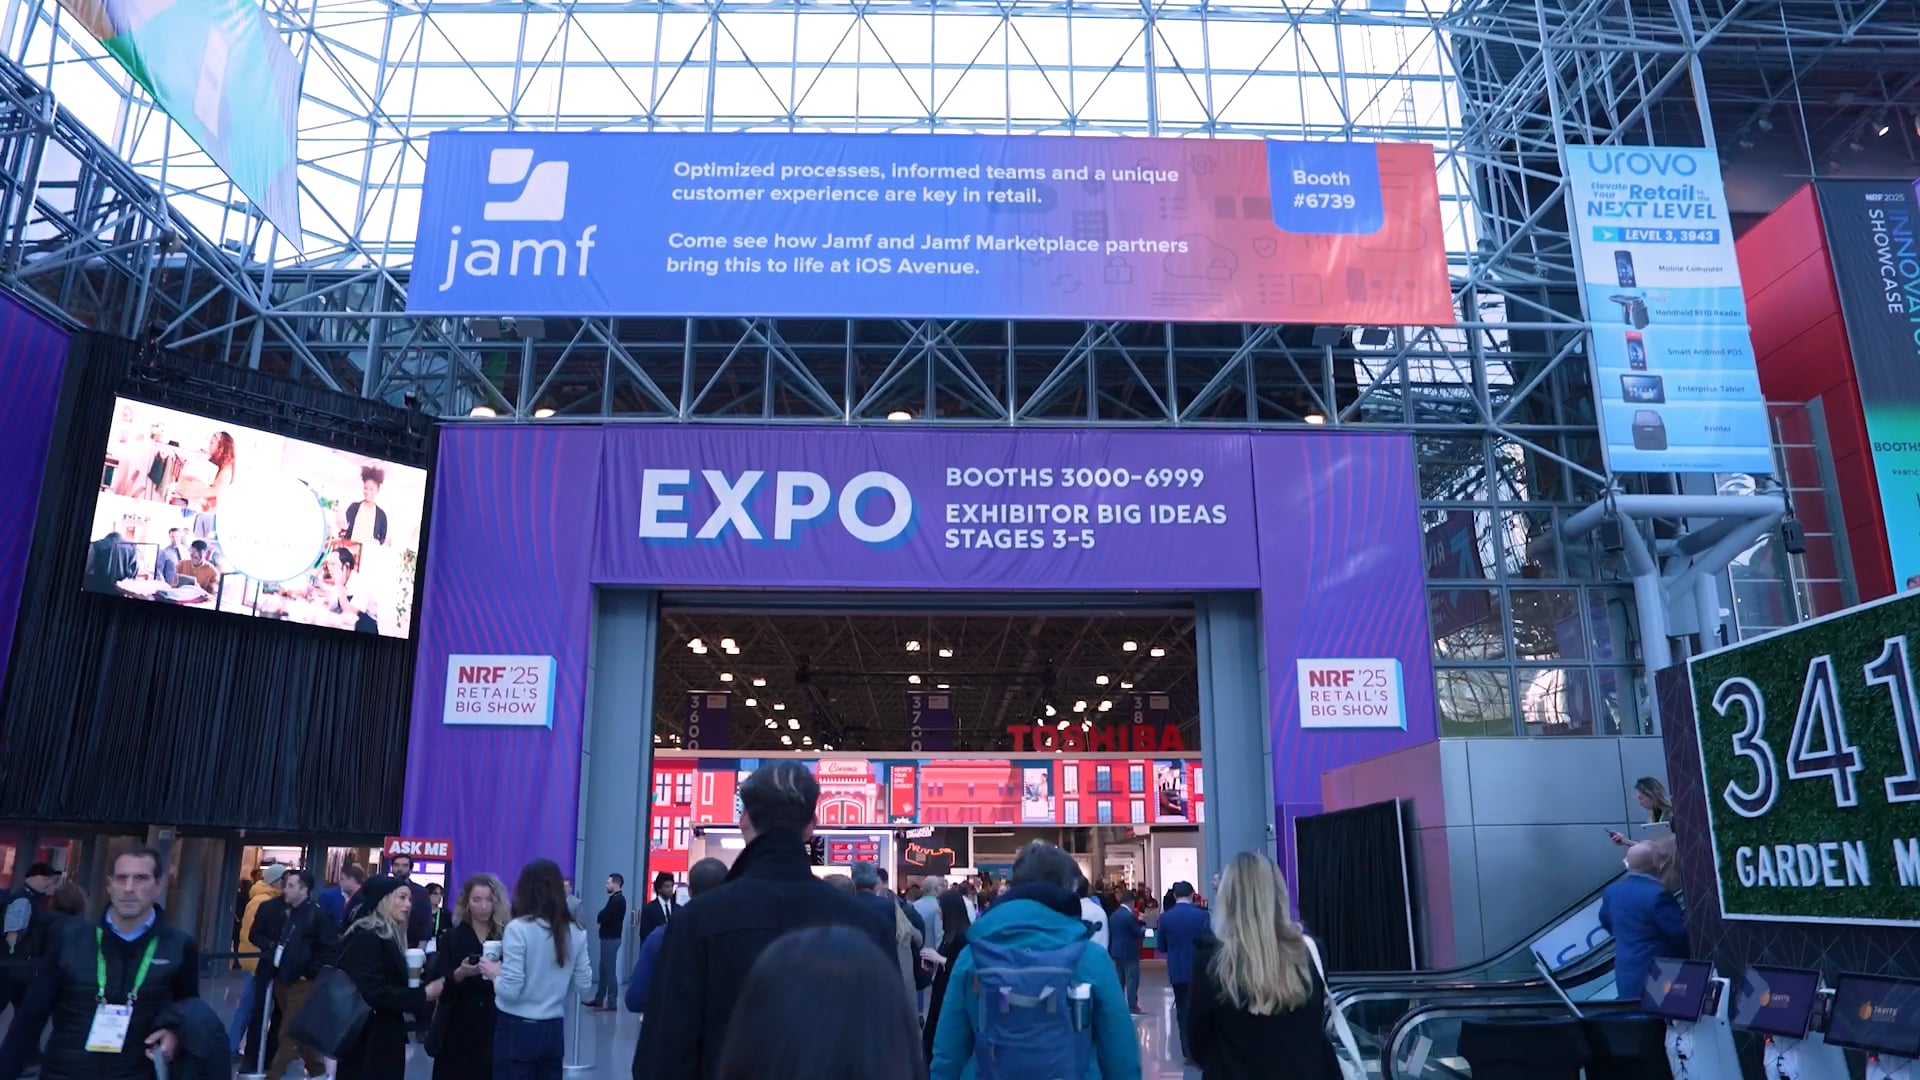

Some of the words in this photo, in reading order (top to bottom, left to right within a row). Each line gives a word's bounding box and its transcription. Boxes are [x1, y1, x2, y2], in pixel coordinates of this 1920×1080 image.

[673, 161, 775, 179] Optimized
[781, 164, 886, 180] processes,
[891, 163, 980, 179] informed
[986, 165, 1046, 180] teams
[1052, 166, 1088, 180] and
[1094, 169, 1106, 180] a
[1112, 166, 1179, 184] unique
[1293, 169, 1351, 186] Booth
[1591, 182, 1628, 190] Elevate
[1629, 184, 1695, 200] Retail
[672, 186, 765, 200] customer
[770, 186, 879, 204] experience
[884, 189, 917, 201] are
[923, 186, 957, 205] key
[963, 187, 980, 202] in
[987, 188, 1042, 203] retail.
[1293, 193, 1356, 209] #6739
[1865, 193, 1883, 201] NRF
[1587, 200, 1648, 218] NEXT
[1653, 203, 1717, 219] LEVEL
[668, 232, 728, 248] Come
[732, 236, 768, 248] see
[773, 233, 817, 248] how
[821, 233, 873, 249] Jamf
[877, 234, 914, 249] and
[920, 235, 971, 250] Jamf
[976, 235, 1099, 254] Marketplace
[1105, 238, 1189, 255] partners
[1625, 229, 1661, 241] LEVEL
[1665, 230, 1678, 242] 3,
[1681, 231, 1714, 242] 3943
[439, 225, 598, 291] jamf
[666, 257, 719, 276] bring
[724, 257, 761, 273] this
[767, 259, 787, 273] to
[793, 257, 824, 273] life
[830, 260, 850, 273] at
[855, 258, 892, 274] iOS
[897, 258, 980, 274] Avenue.
[1868, 208, 1904, 314] SHOWCASE
[1888, 208, 1920, 354] INNOVA
[1655, 309, 1693, 317] Handheld
[1667, 348, 1691, 356] Smart
[1693, 348, 1725, 356] Android
[1678, 385, 1718, 394] Enterprise
[1720, 385, 1745, 393] Tablet
[1704, 425, 1732, 433] Printer
[946, 467, 1053, 487] BOOTHS
[638, 468, 915, 543] EXPO
[946, 504, 1089, 524] EXHIBITOR
[1097, 504, 1142, 524] BIG
[1150, 504, 1227, 524] IDEAS
[945, 529, 1045, 549] STAGES
[458, 666, 506, 684] NRF
[1309, 669, 1355, 687] NRF
[457, 687, 537, 699] RETAIL'S
[1310, 690, 1388, 702] RETAIL'S
[456, 701, 482, 713] BIG
[487, 701, 536, 713] SHOW
[1311, 705, 1337, 716] BIG
[1342, 704, 1388, 716] SHOW
[1712, 635, 1920, 818] 341
[1006, 723, 1185, 752] TOSHIBA
[389, 841, 422, 855] ASK
[424, 842, 449, 856] ME
[1736, 840, 1870, 887] GARDEN
